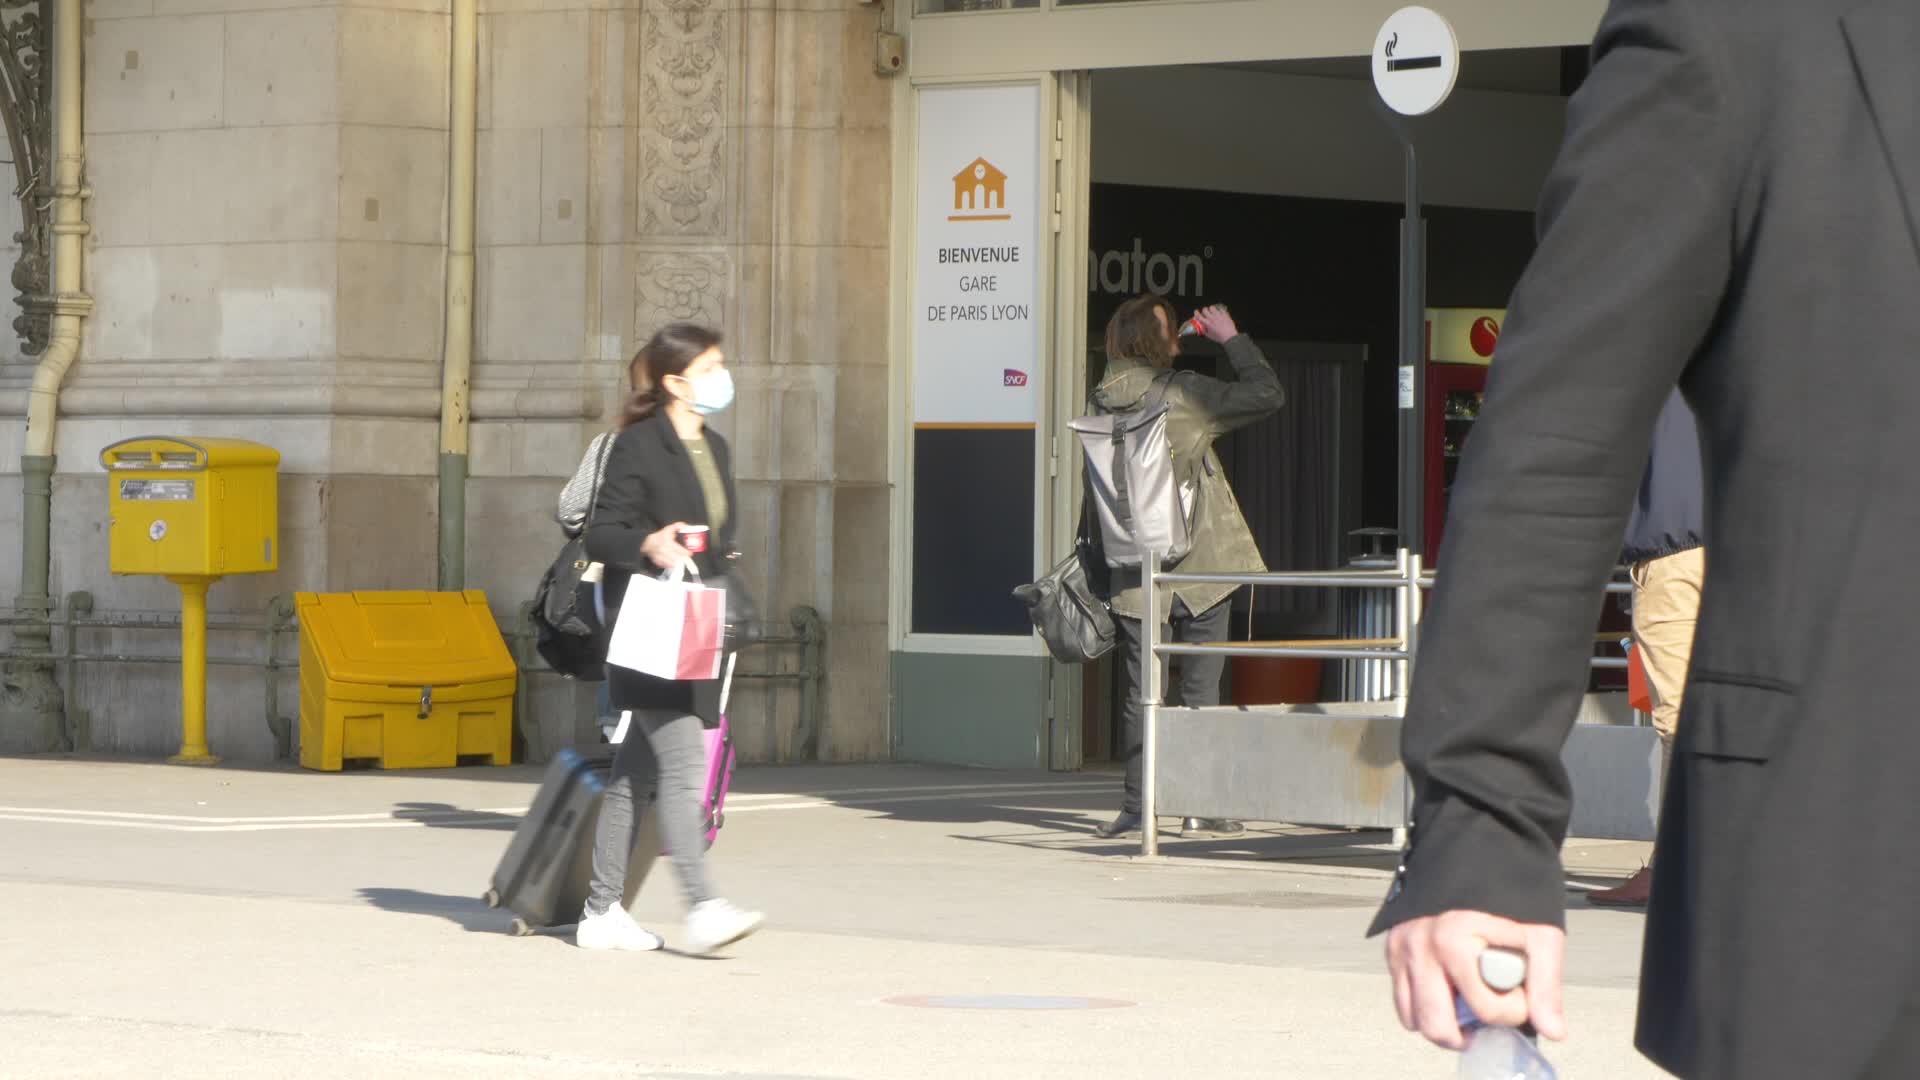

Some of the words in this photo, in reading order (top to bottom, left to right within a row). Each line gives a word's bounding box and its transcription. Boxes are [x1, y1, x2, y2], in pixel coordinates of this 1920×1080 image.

[938, 247, 1020, 264] BIENVENUE
[959, 275, 998, 292] GARE
[927, 305, 947, 322] DE
[950, 304, 988, 321] PARIS
[992, 304, 1028, 321] LYON
[1004, 375, 1026, 385] SNCF
